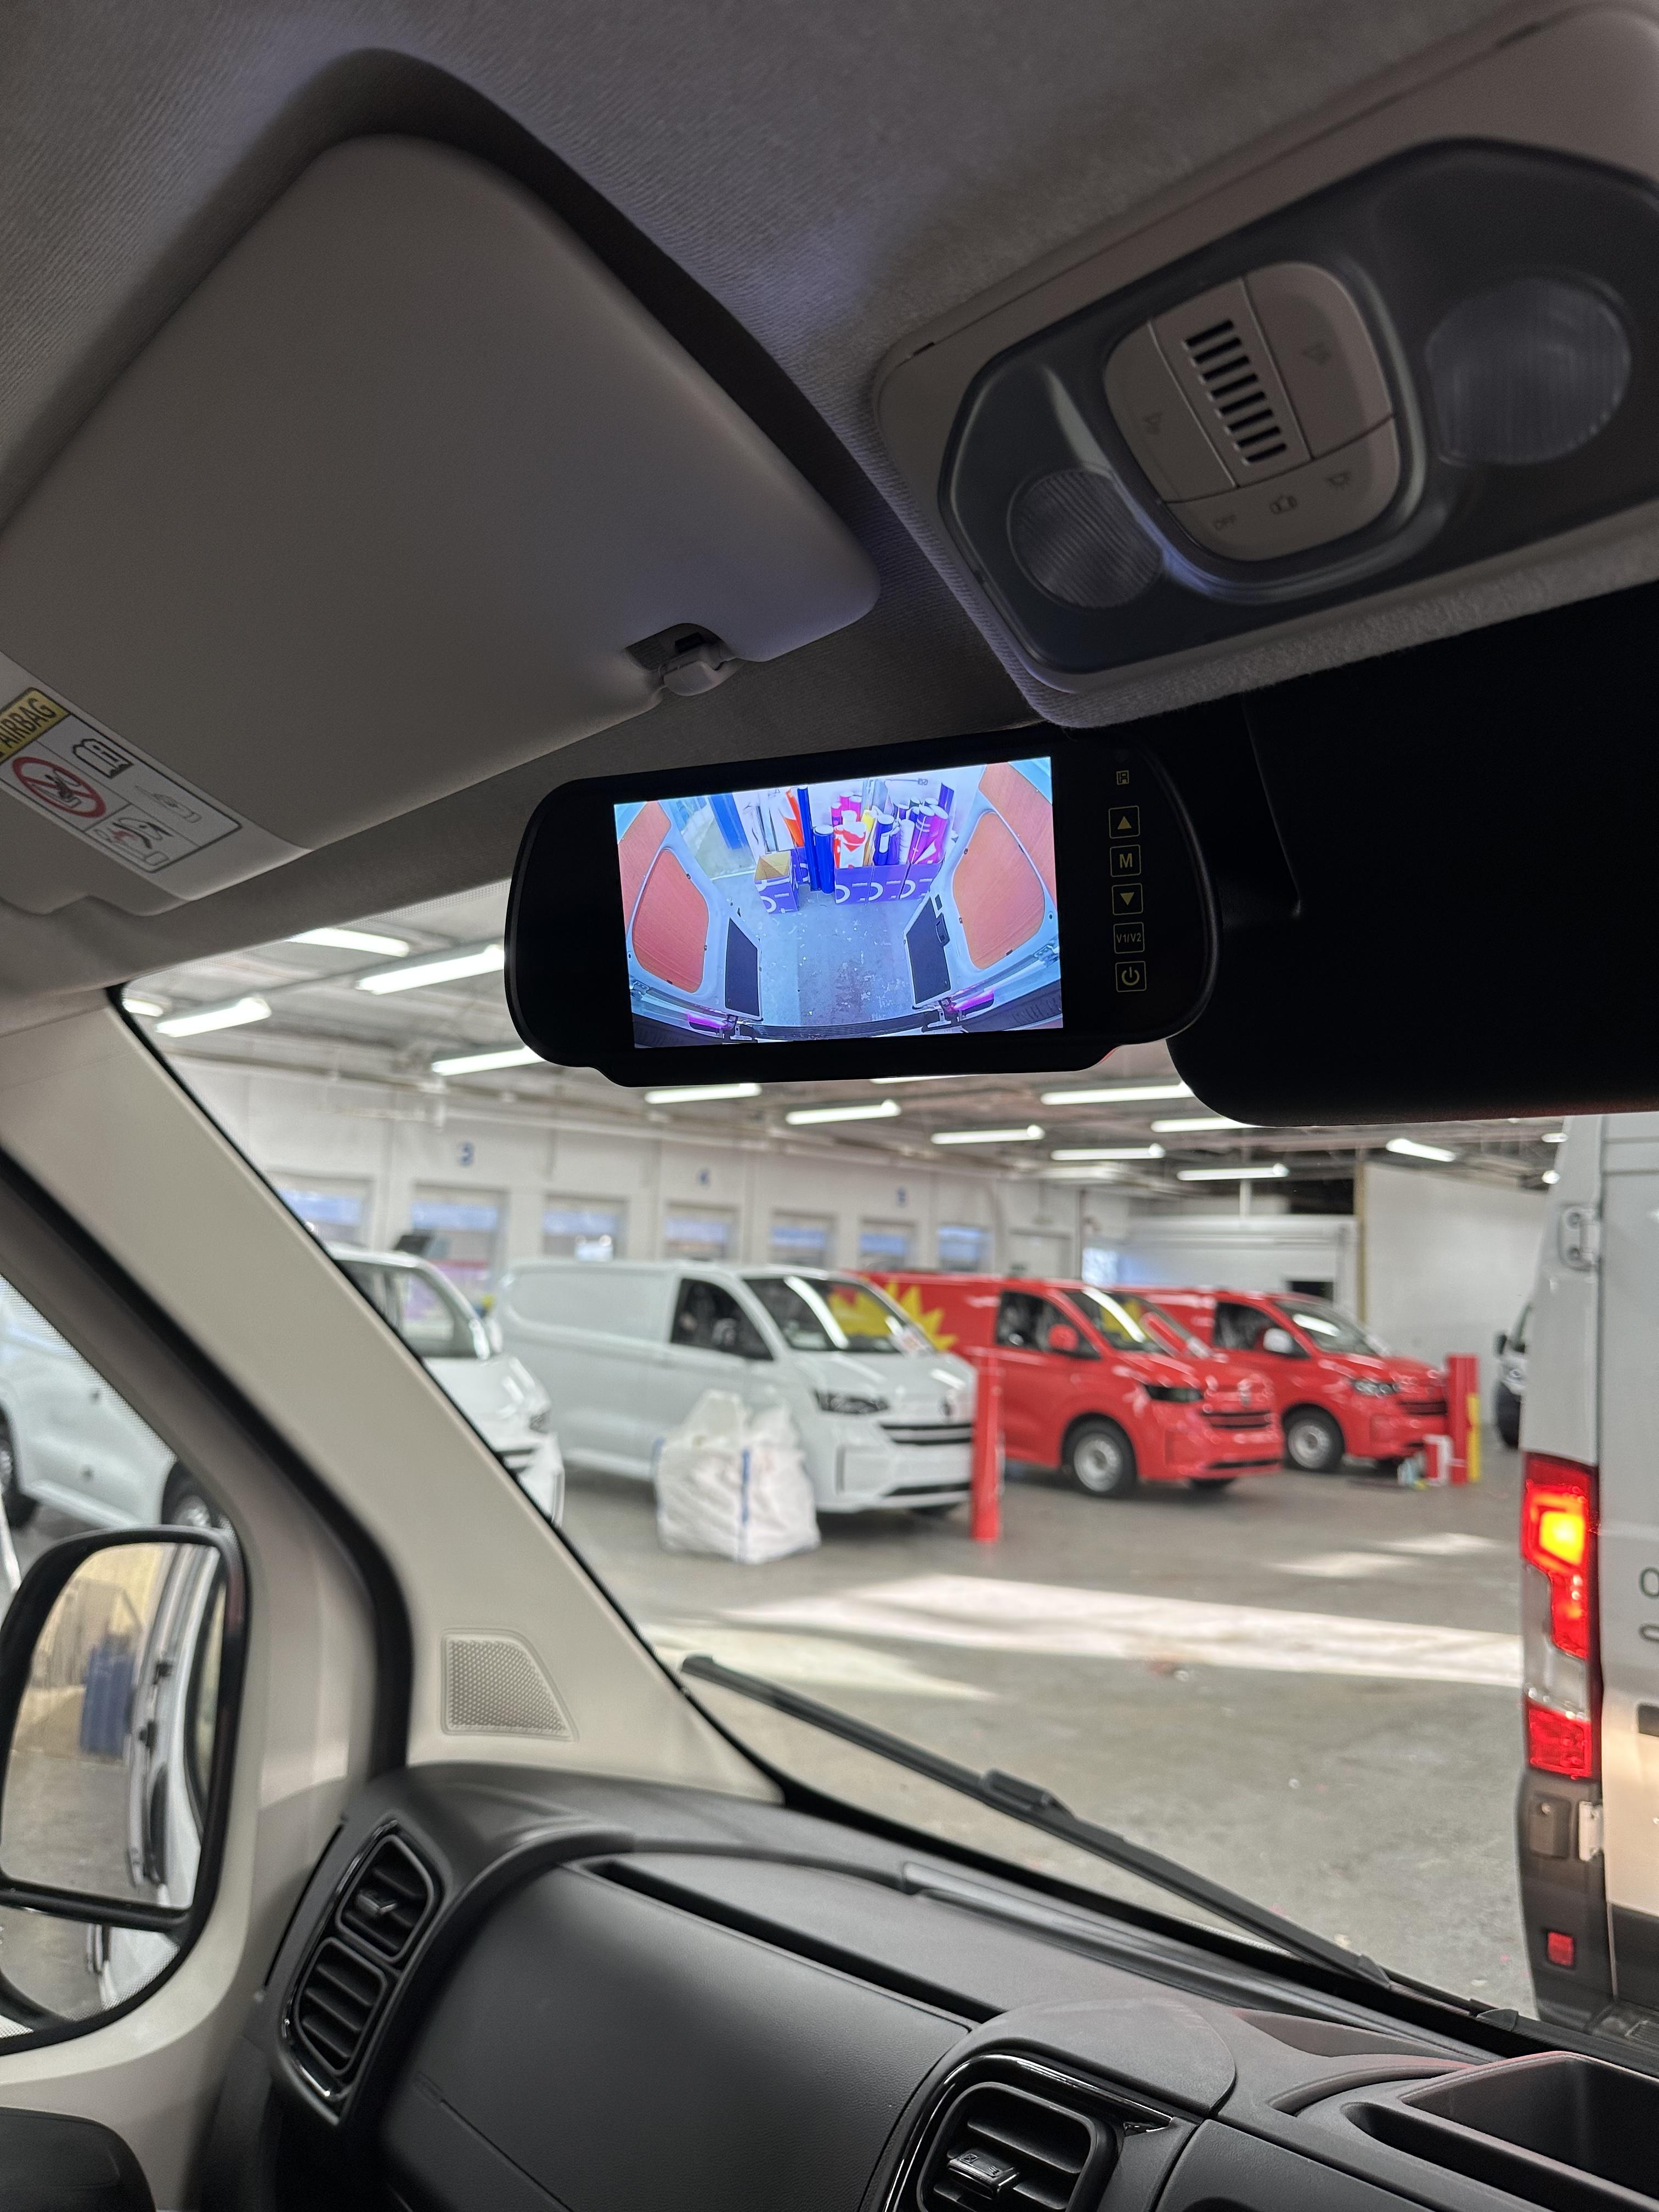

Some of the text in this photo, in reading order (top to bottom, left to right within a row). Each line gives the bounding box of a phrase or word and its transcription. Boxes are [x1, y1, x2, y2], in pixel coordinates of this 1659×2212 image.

[0, 697, 57, 749] AIRBAG
[1120, 853, 1133, 868] M
[1116, 933, 1142, 944] V1/V2
